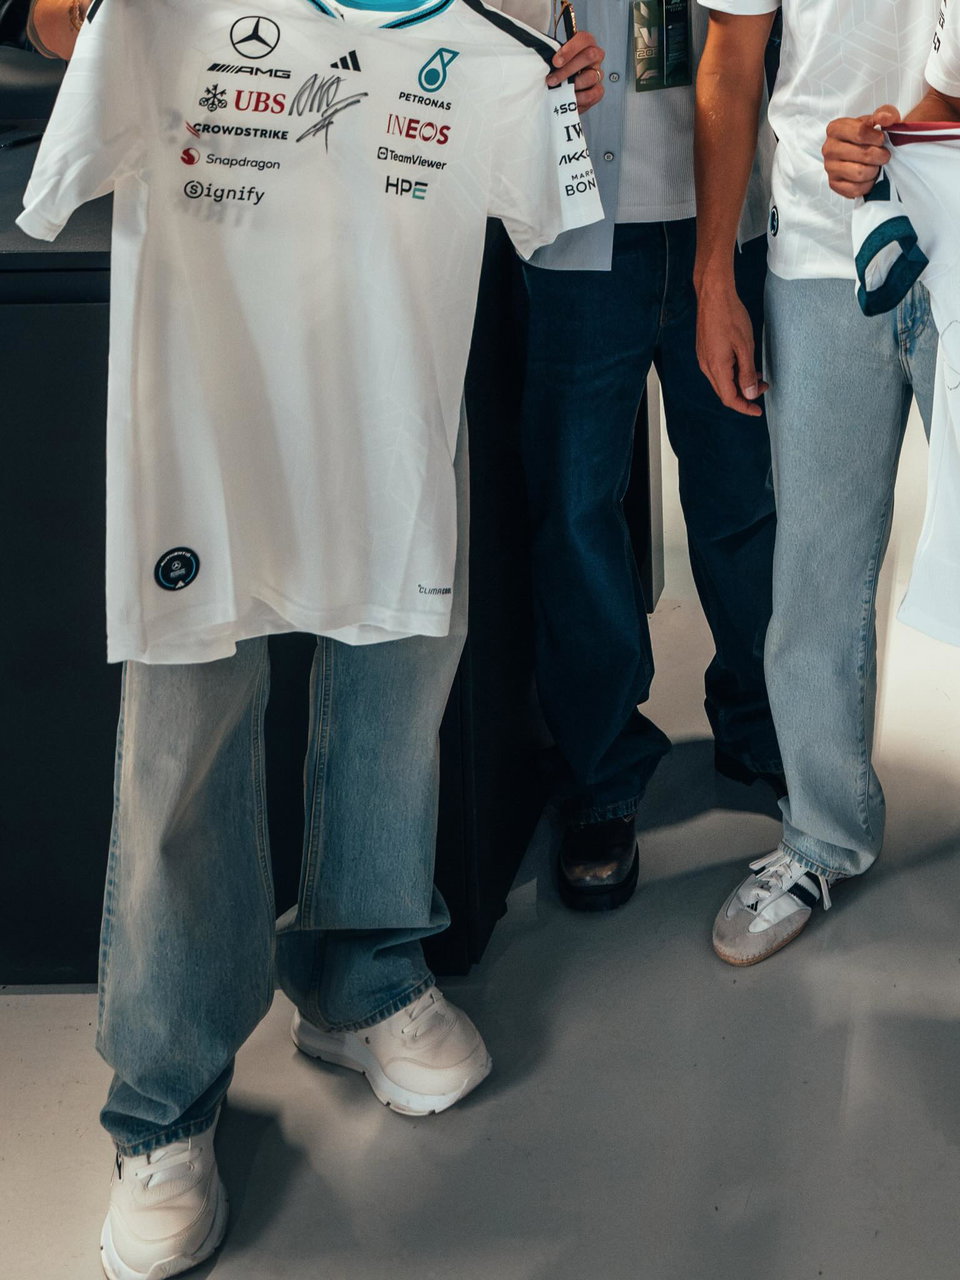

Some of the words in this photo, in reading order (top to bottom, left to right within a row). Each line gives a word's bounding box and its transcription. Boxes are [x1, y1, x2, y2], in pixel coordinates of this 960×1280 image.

[234, 66, 292, 80] AMG
[233, 89, 286, 114] UBS
[398, 91, 452, 111] PETRONAS
[193, 123, 289, 140] CROWDSTRIKE
[386, 113, 452, 146] INEOS
[206, 153, 281, 170] Snapdragon
[389, 149, 447, 171] TeamViewer
[385, 175, 429, 200] HPE
